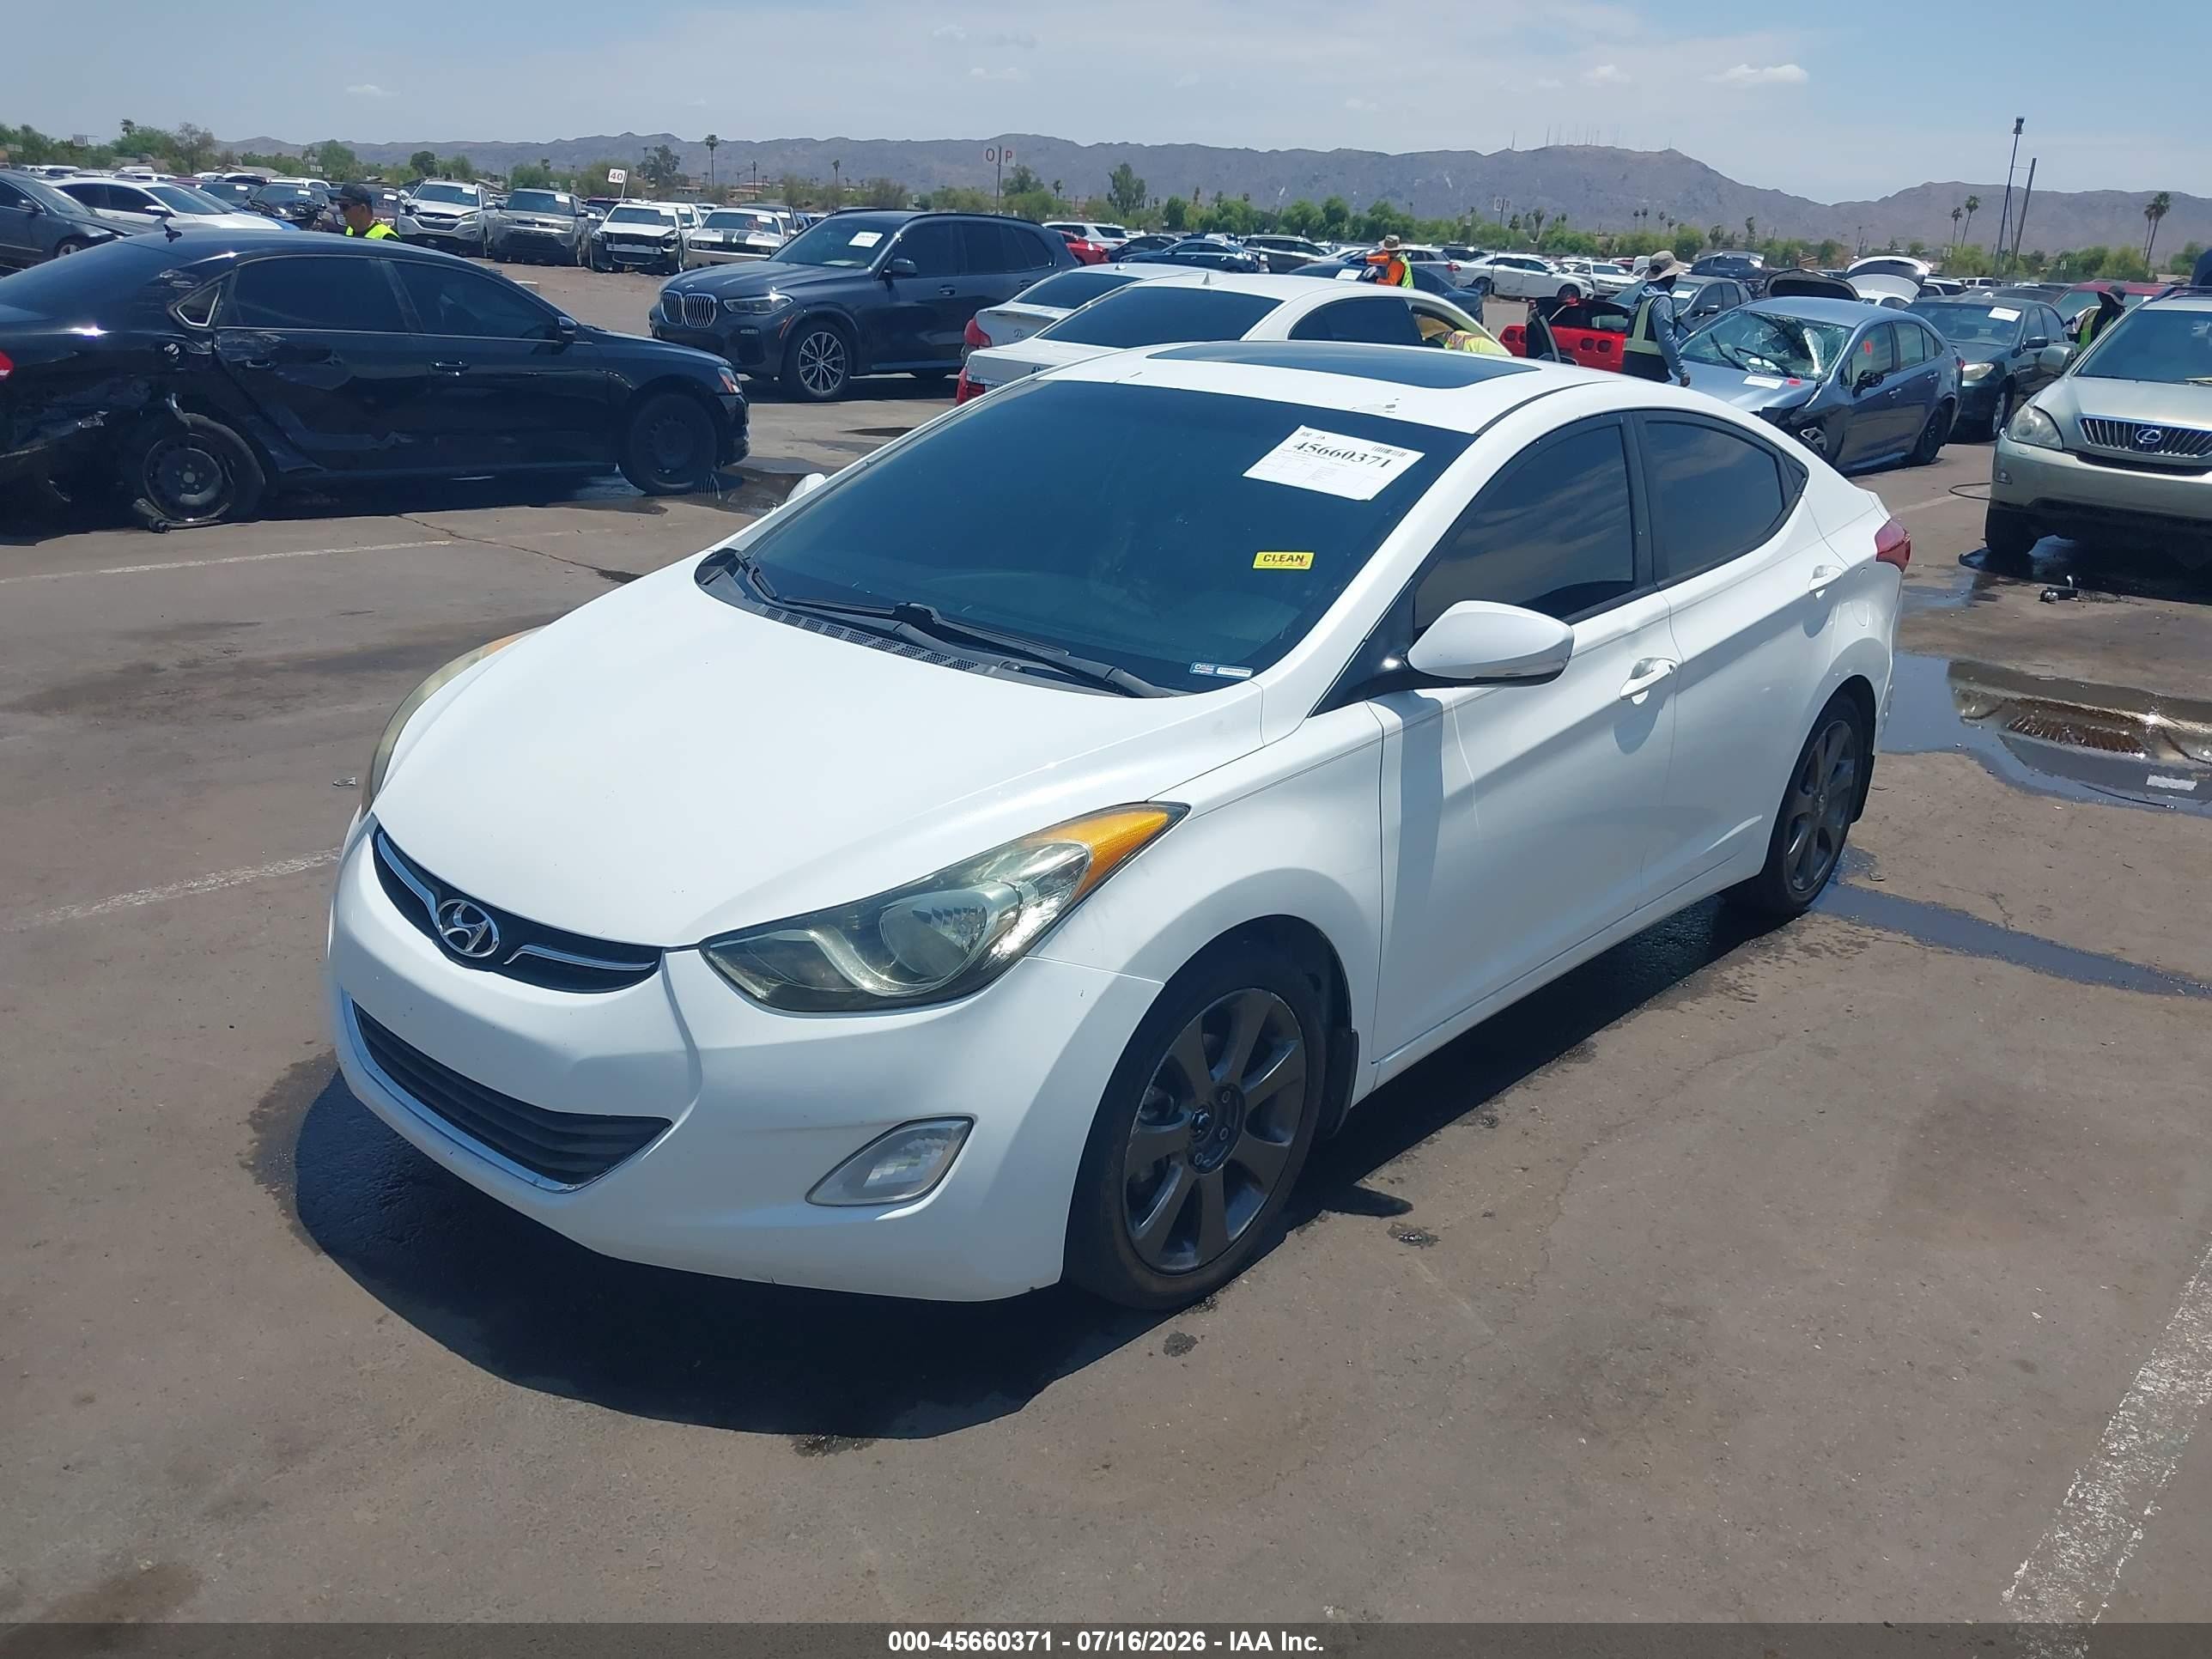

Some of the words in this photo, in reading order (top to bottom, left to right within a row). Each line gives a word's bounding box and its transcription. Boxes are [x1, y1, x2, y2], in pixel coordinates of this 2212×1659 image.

[1006, 150, 1012, 163] P
[1292, 441, 1392, 468] 45660371
[1263, 554, 1304, 562] CLEAN
